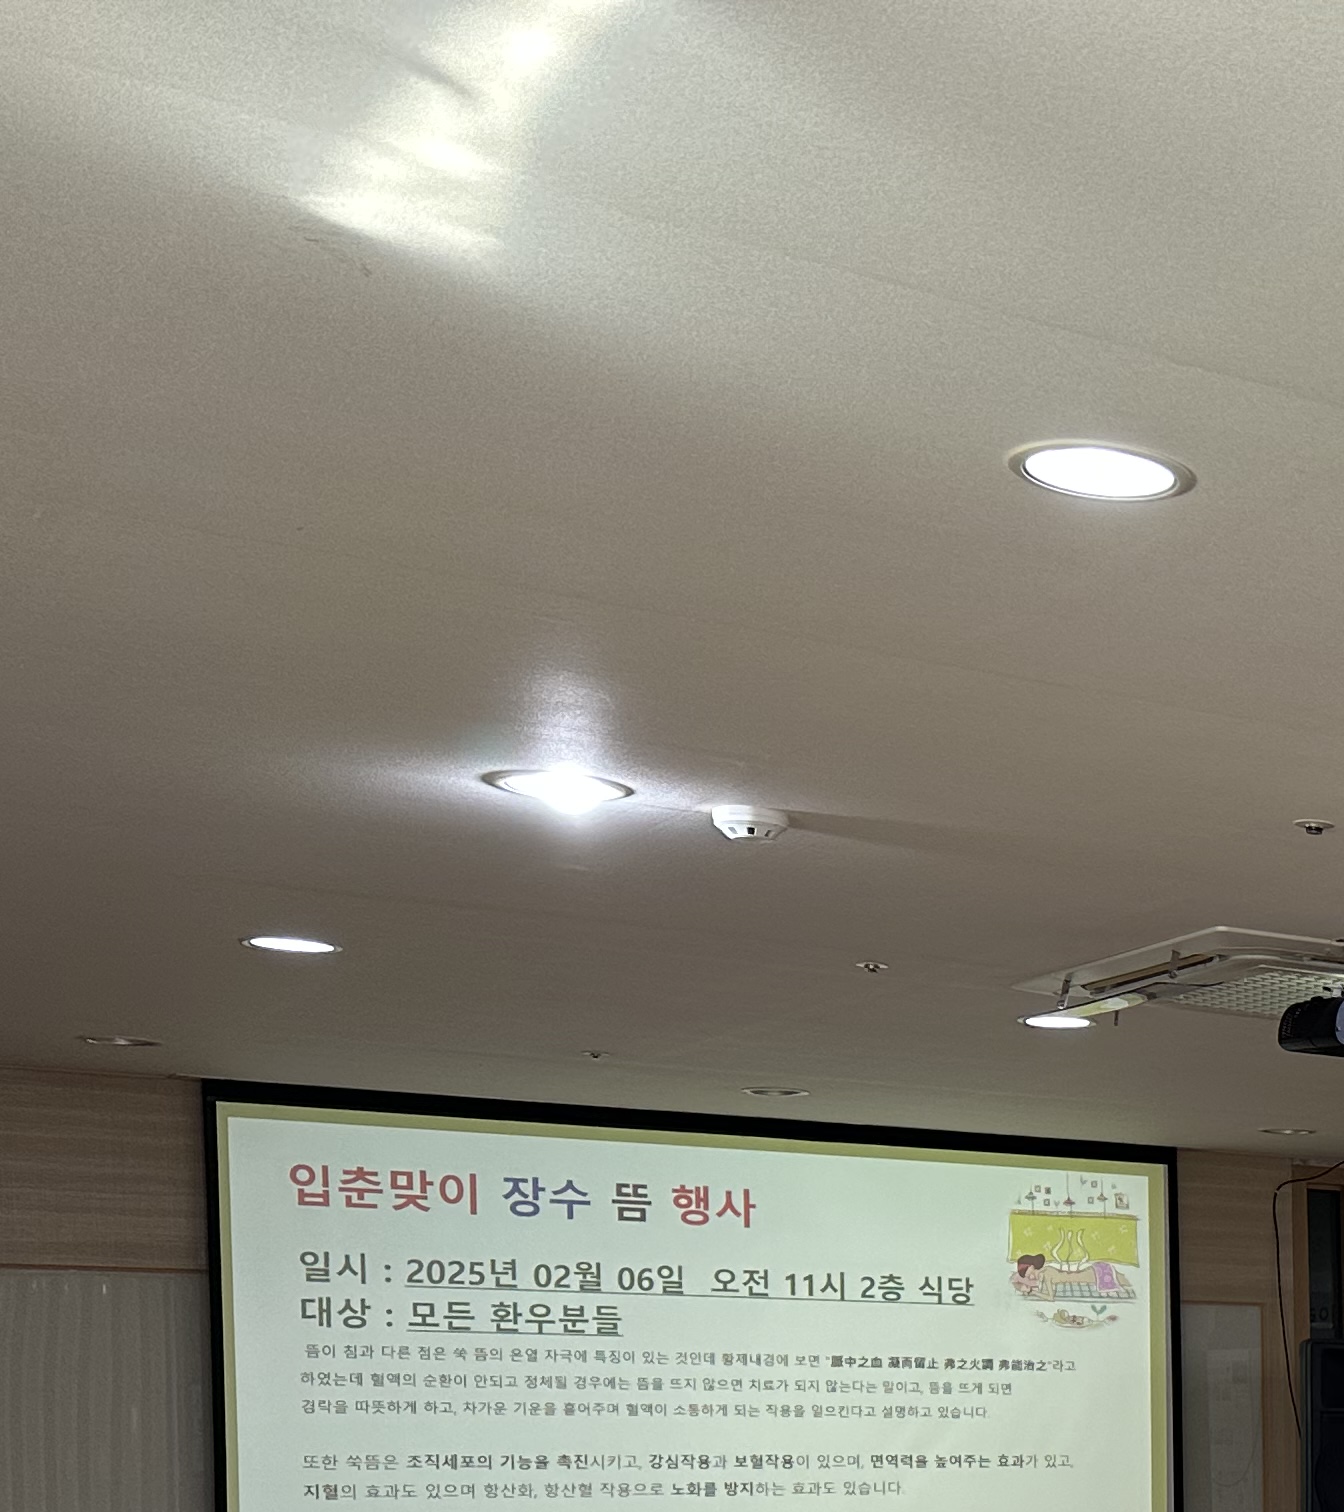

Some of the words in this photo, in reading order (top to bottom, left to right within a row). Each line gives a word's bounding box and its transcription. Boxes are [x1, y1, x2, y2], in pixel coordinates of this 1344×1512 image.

[288, 1163, 478, 1216] 입춘맞이
[501, 1176, 592, 1221] 장수
[610, 1182, 653, 1223] 뜸
[671, 1183, 757, 1229] 행사
[299, 1250, 367, 1285] 일시
[405, 1258, 518, 1290] 2025년
[533, 1261, 603, 1293] 02월
[617, 1264, 684, 1296] 06일
[710, 1268, 770, 1297] 오전
[785, 1271, 846, 1300] 11시
[860, 1274, 905, 1302] 2층
[919, 1275, 975, 1305] 식당
[300, 1296, 371, 1329] 대상
[408, 1301, 475, 1332] 모든
[490, 1302, 623, 1336] 환우분들
[304, 1343, 336, 1359] 뜸이
[381, 1345, 412, 1361] 다른
[452, 1347, 469, 1362] 쑥
[473, 1347, 503, 1362] 뜸의
[508, 1347, 538, 1363] 온열
[544, 1348, 588, 1364] 자극에
[641, 1350, 670, 1366] 있는
[674, 1351, 716, 1366] 것인데
[794, 1354, 820, 1369] 보면
[299, 1371, 364, 1388] 하였는데
[422, 1373, 468, 1389] 순환이
[473, 1373, 519, 1389] 안되고
[573, 1375, 631, 1391] 경우에는
[636, 1376, 665, 1392] 뜸을
[669, 1377, 697, 1391] 뜨지
[701, 1377, 743, 1393] 않으면
[748, 1378, 790, 1393] 치료가
[794, 1379, 820, 1393] 되지
[825, 1379, 878, 1394] 않는다는
[928, 1381, 953, 1395] 뜸을
[957, 1381, 983, 1396] 뜨게
[987, 1382, 1012, 1396] 되면
[301, 1399, 349, 1415] 경락을
[354, 1399, 417, 1415] 따뜻하게
[423, 1400, 457, 1417] 하고,
[462, 1400, 509, 1416] 차가운
[513, 1401, 558, 1417] 기운을
[672, 1403, 728, 1418] 소통하게
[733, 1403, 761, 1418] 되는
[765, 1403, 806, 1418] 작용을
[811, 1403, 877, 1419] 일으킨다고
[302, 1453, 340, 1471] 또한
[405, 1453, 493, 1471] 조직세포의
[499, 1453, 551, 1471] 기능을
[648, 1453, 729, 1471] 강심작용과
[870, 1453, 929, 1470] 면역력을
[933, 1453, 992, 1469] 높여주는
[996, 1453, 1039, 1469] 효과가
[364, 1483, 419, 1501] 효과도
[425, 1482, 476, 1500] 있으며
[599, 1482, 665, 1499] 작용으로
[670, 1481, 718, 1498] 노화를
[723, 1480, 787, 1497] 방지하는
[791, 1481, 837, 1497] 효과도
